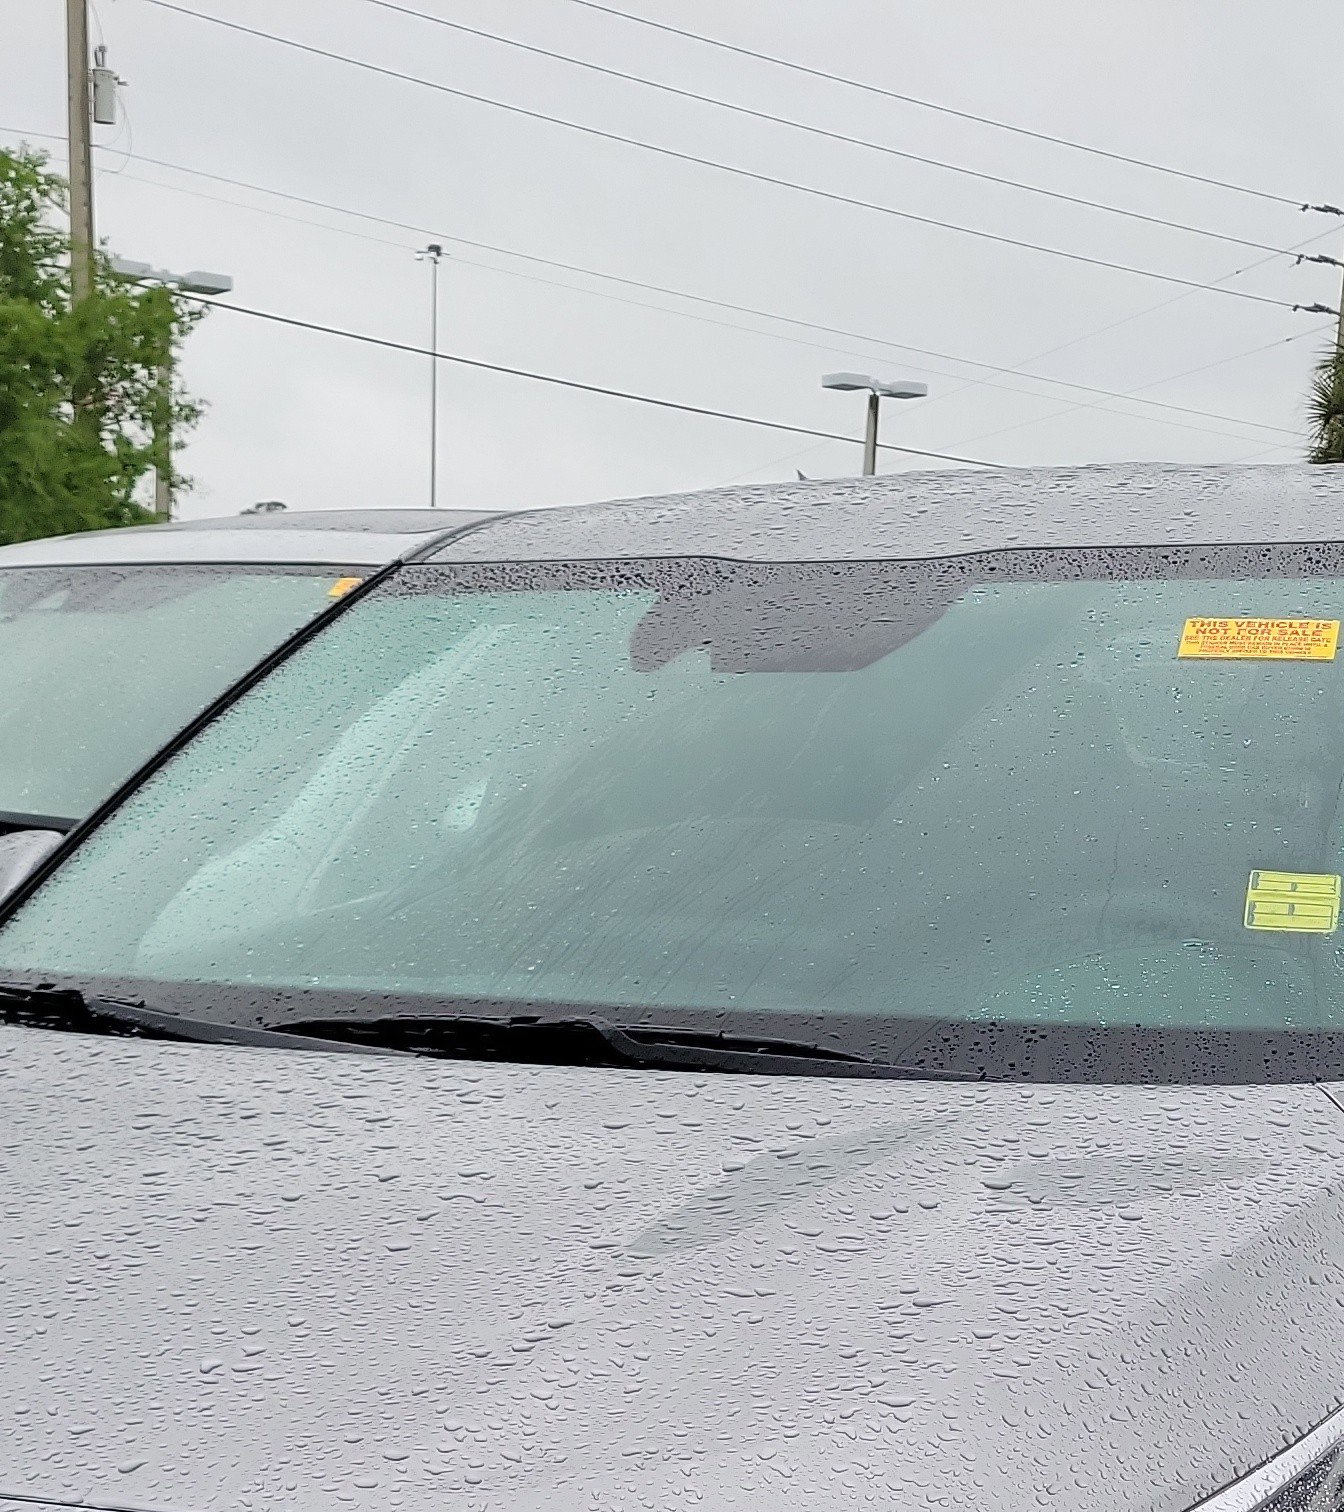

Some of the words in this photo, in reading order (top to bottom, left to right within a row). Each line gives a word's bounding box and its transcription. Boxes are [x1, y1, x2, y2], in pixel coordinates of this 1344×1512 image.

[1189, 620, 1228, 628] THIS
[1234, 621, 1309, 629] VEHICLE
[1315, 622, 1332, 630] IS
[1236, 628, 1272, 636] FOR
[1277, 629, 1323, 637] SALE
